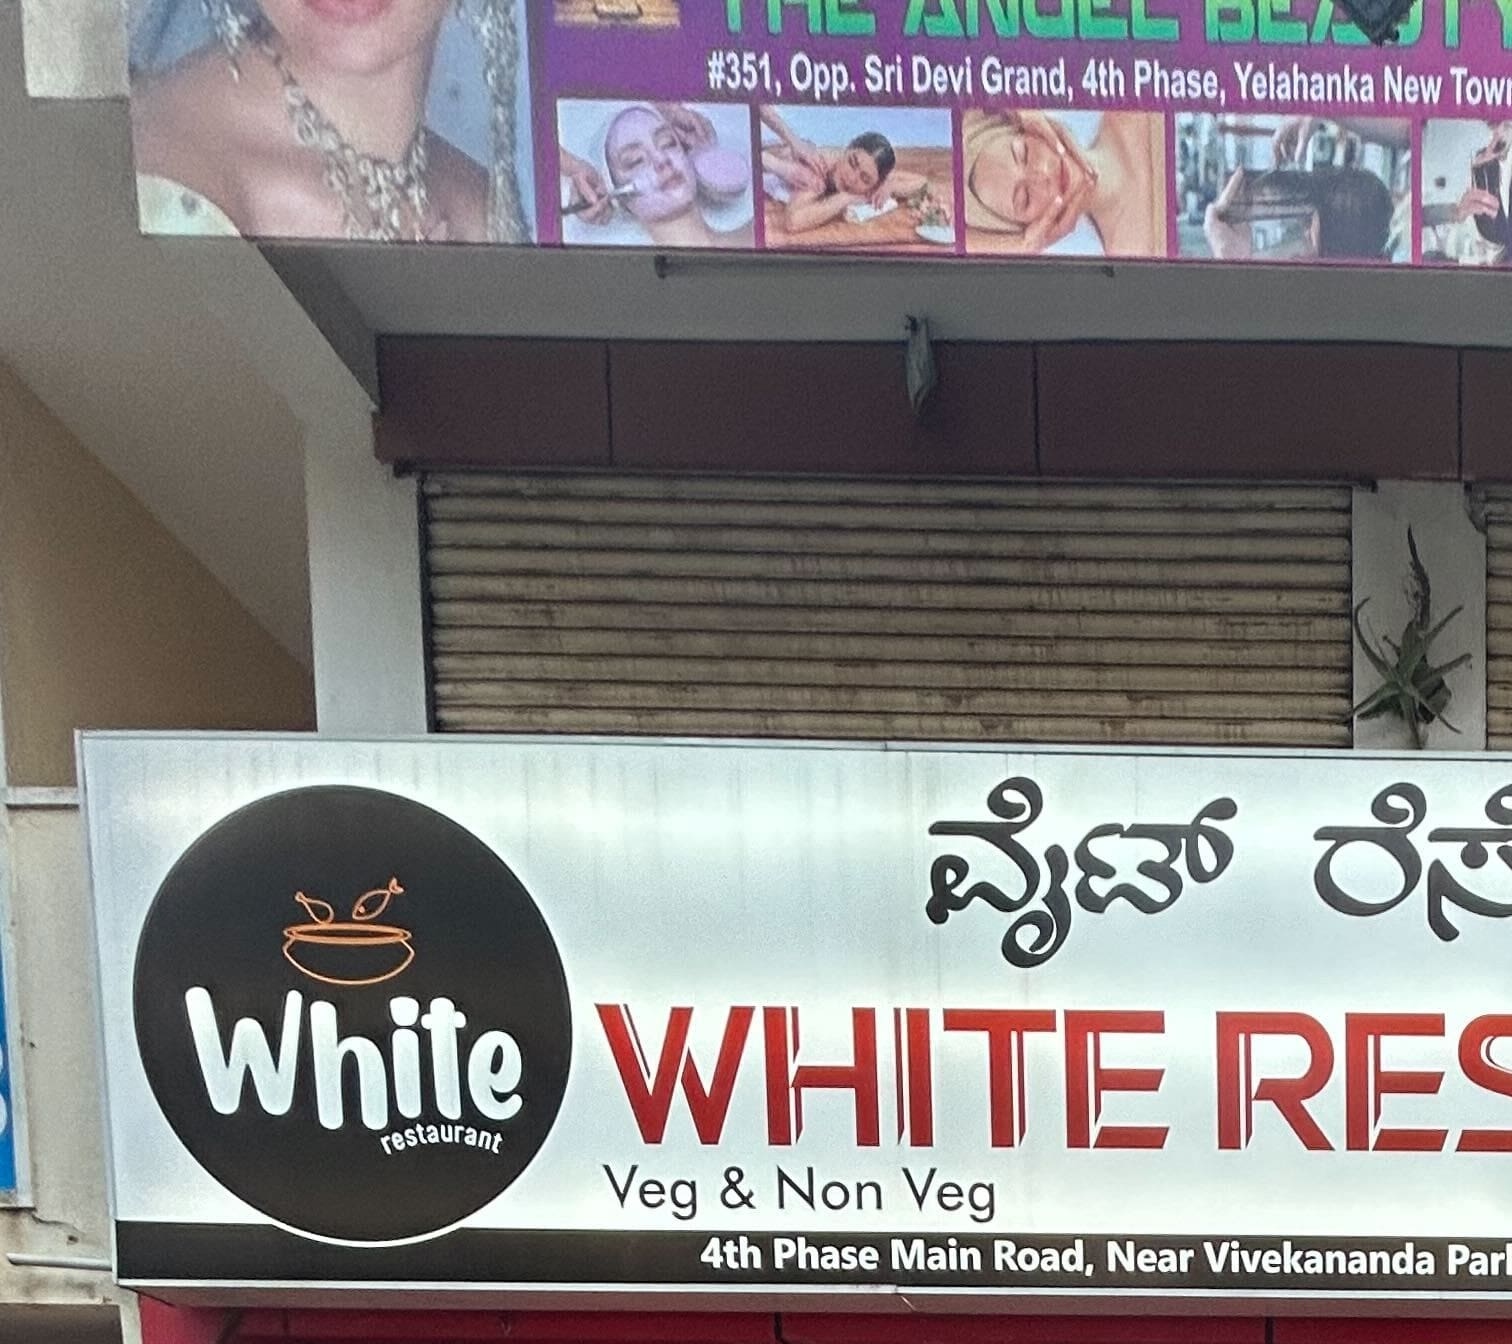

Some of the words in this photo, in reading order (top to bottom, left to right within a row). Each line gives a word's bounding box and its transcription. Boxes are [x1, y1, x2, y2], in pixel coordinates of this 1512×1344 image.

[707, 51, 782, 98] #351,
[789, 53, 857, 101] Opp.
[864, 55, 902, 95] Sri
[911, 56, 973, 96] Devi
[980, 56, 1075, 103] Grand,
[1081, 58, 1125, 99] 4th
[1138, 59, 1227, 106] Phase,
[1234, 61, 1374, 107] Yelahanka
[1383, 66, 1442, 107] New
[927, 775, 1239, 969] ವೈಟ್
[185, 985, 524, 1131] White
[594, 1002, 1171, 1150] WHITE
[380, 1123, 503, 1156] restaurant
[602, 1163, 698, 1221] Veg
[719, 1165, 756, 1211] &
[777, 1165, 883, 1212] Non
[901, 1167, 996, 1223] Veg
[698, 1235, 763, 1271] 4th
[773, 1236, 880, 1272] Phase
[889, 1238, 983, 1273] Main
[992, 1239, 1096, 1279] Road,
[1106, 1241, 1195, 1275] Near
[1202, 1240, 1436, 1276] Vivekananda
